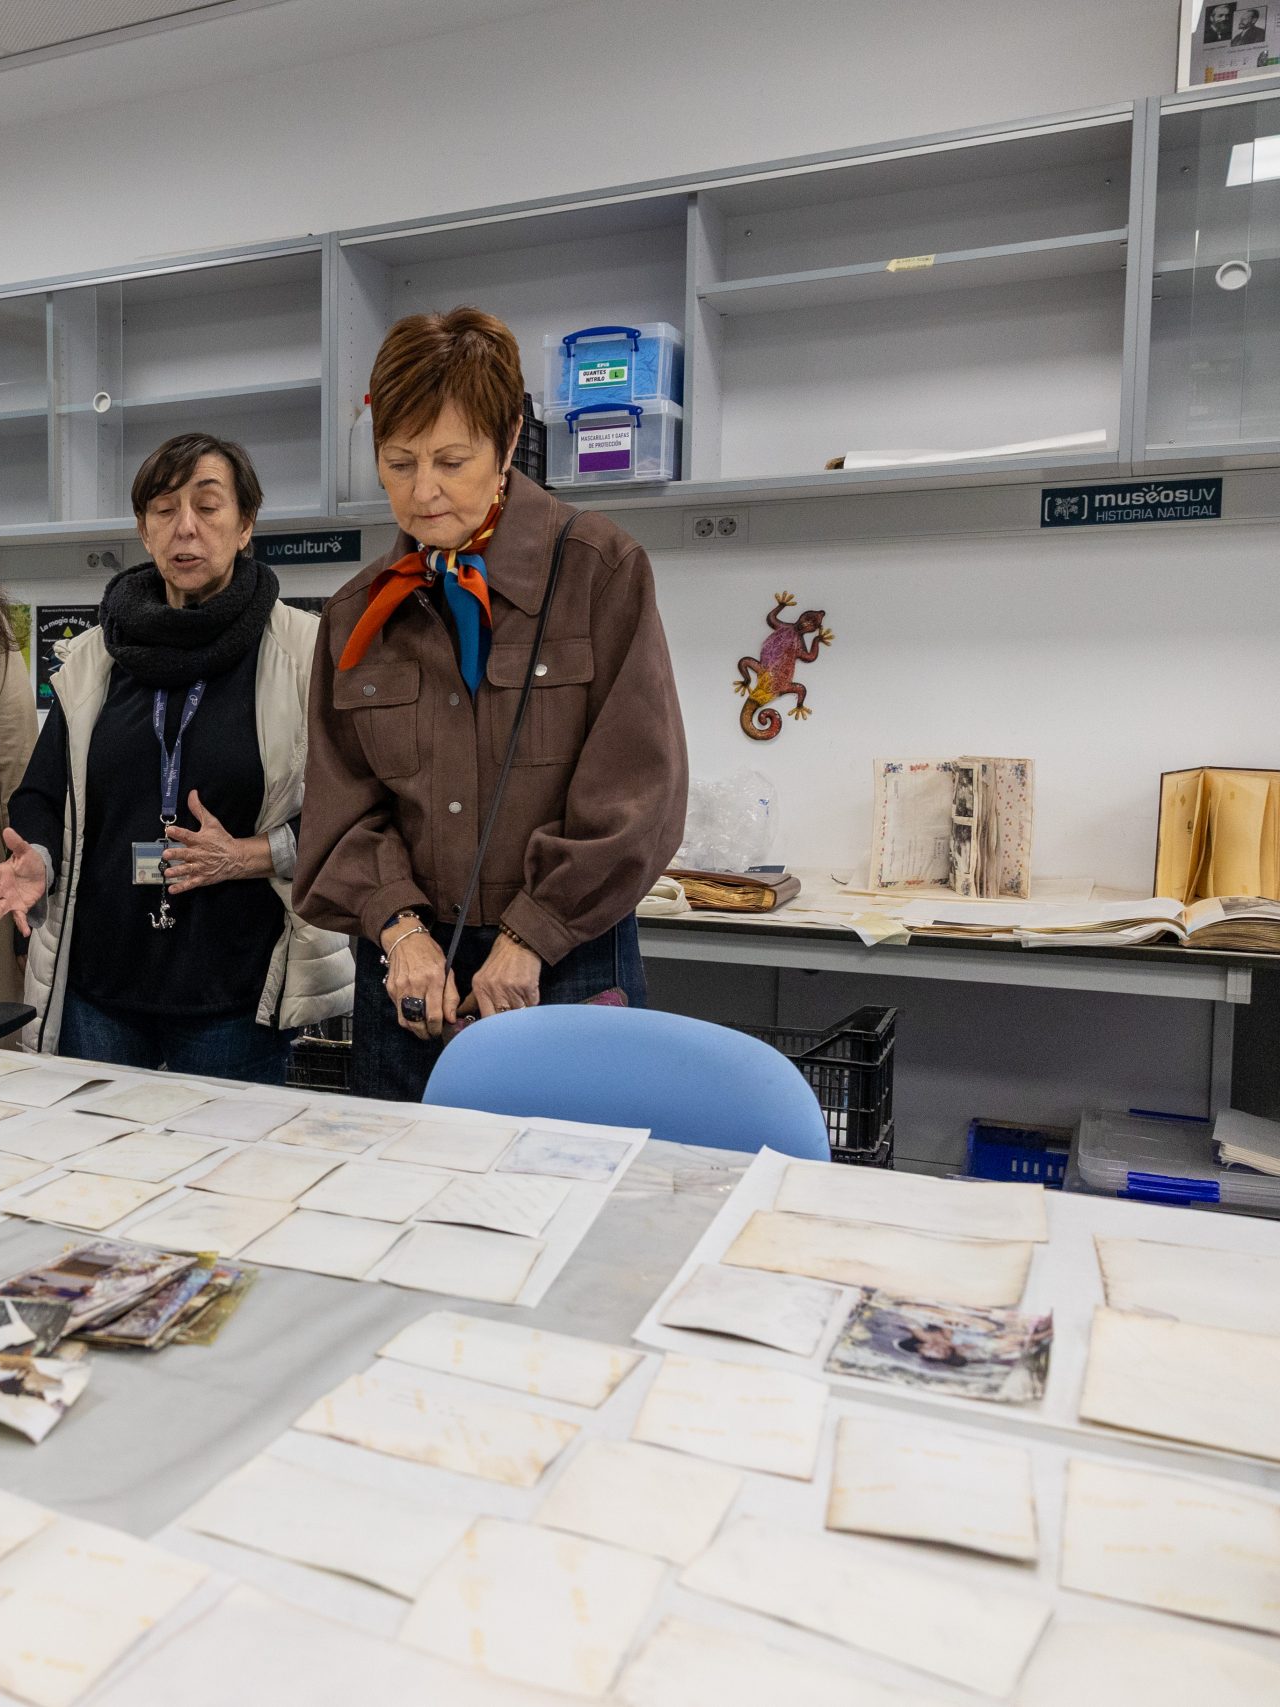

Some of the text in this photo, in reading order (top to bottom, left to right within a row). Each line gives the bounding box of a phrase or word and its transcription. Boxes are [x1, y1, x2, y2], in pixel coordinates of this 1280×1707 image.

[595, 440, 621, 448] PROTECCIÓN
[1096, 506, 1216, 522] HISTORIA NATURAL
[267, 536, 342, 555] uvcultura
[49, 616, 68, 627] magia
[79, 618, 85, 626] la
